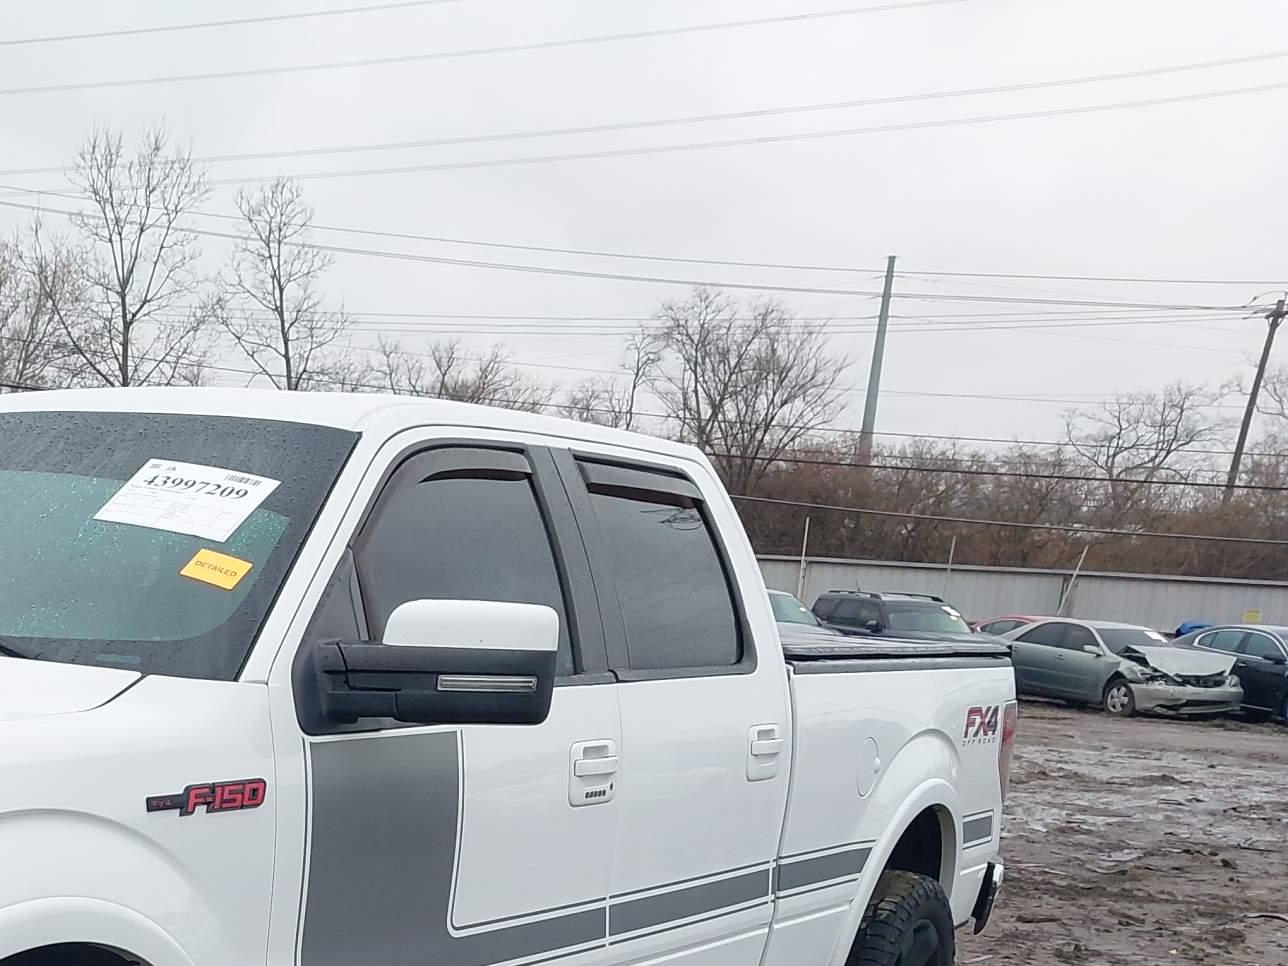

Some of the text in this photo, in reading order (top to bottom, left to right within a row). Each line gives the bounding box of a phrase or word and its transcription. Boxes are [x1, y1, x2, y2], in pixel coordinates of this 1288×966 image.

[143, 474, 249, 500] 43997209
[194, 560, 238, 577] DETAILED
[963, 704, 1000, 739] FX4
[186, 781, 266, 814] F-150
